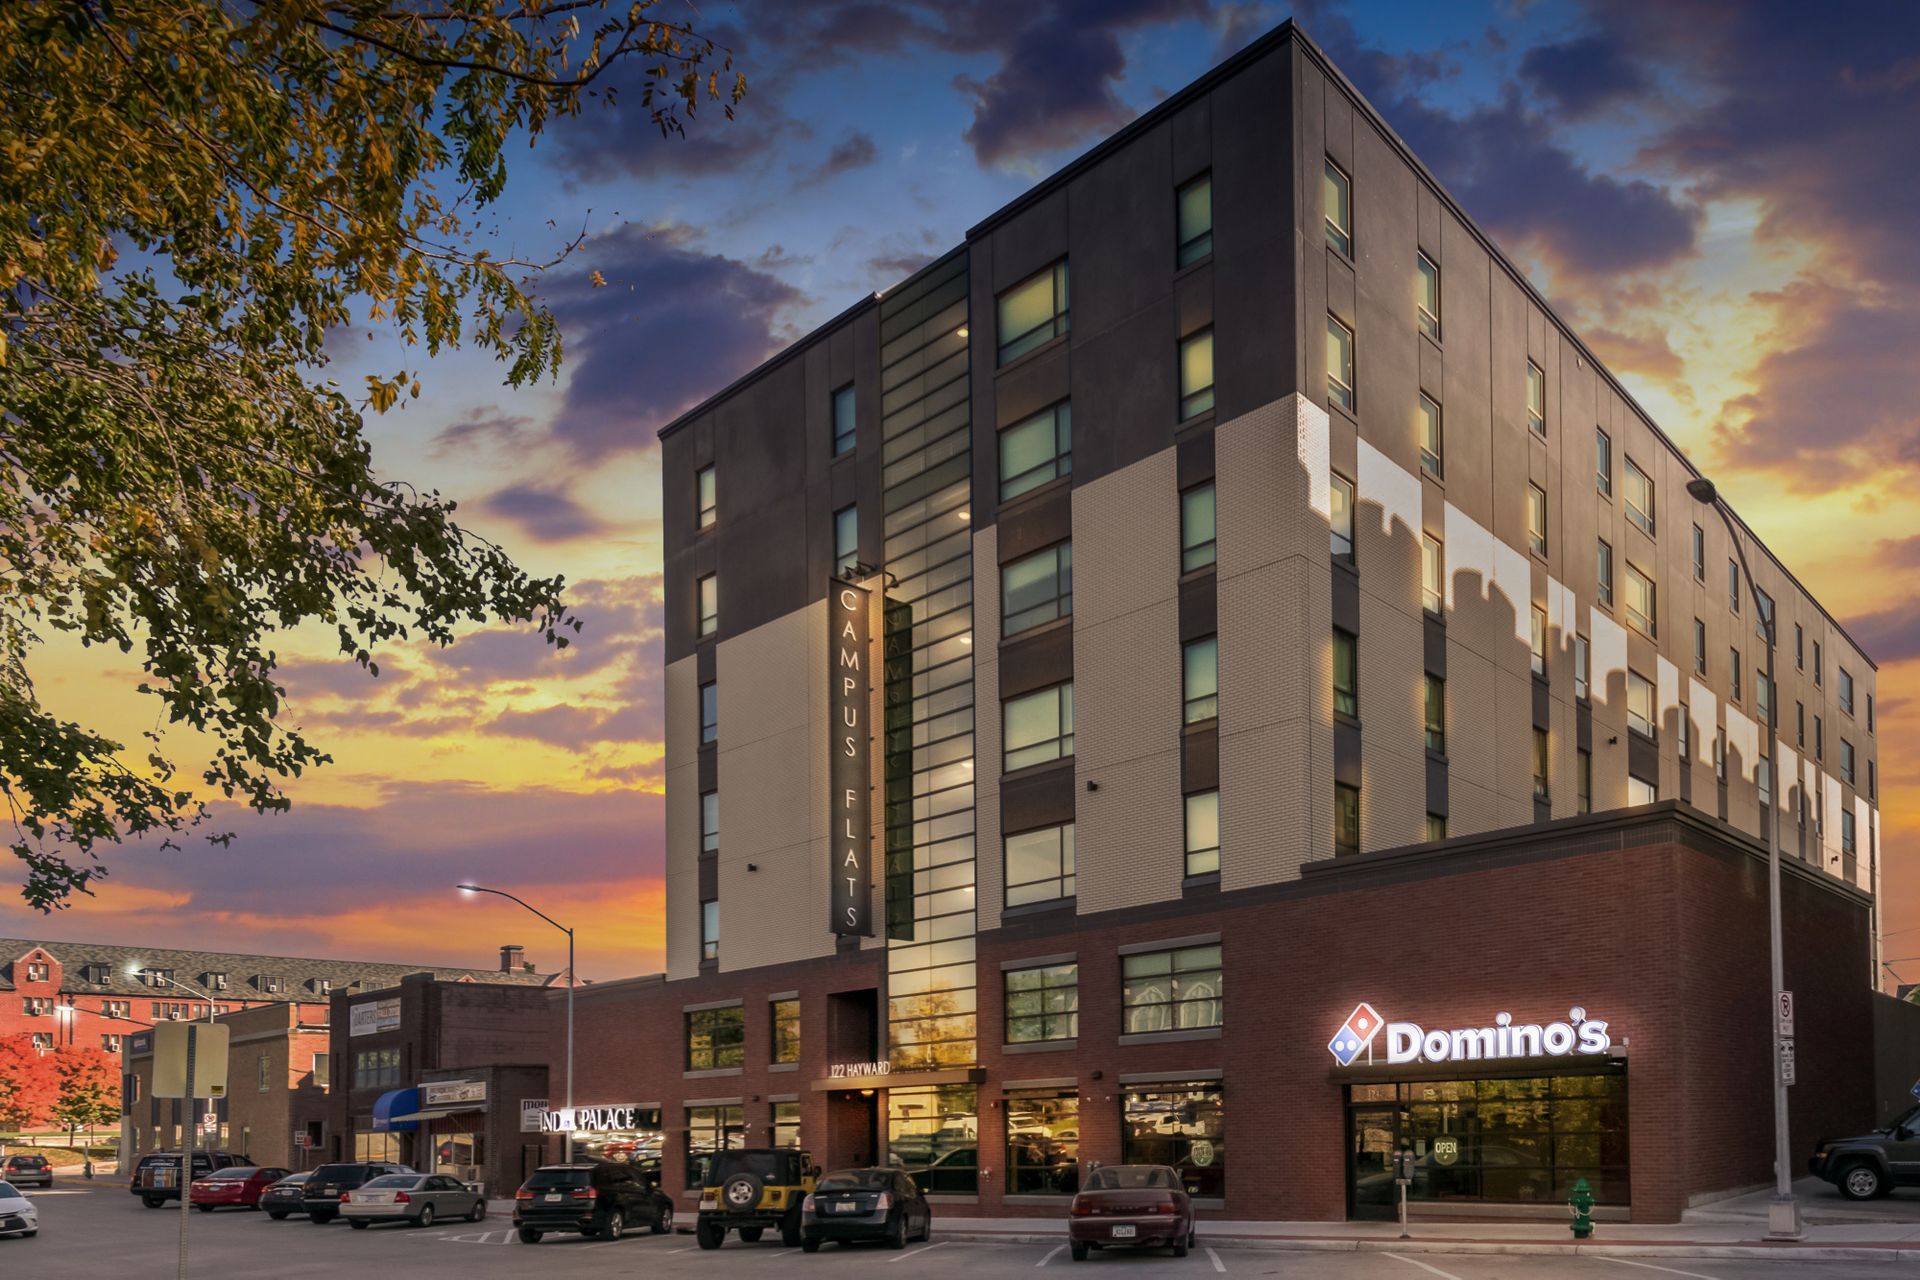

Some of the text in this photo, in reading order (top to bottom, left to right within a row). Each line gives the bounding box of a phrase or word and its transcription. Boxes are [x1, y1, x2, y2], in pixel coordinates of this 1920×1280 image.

[840, 590, 859, 927] CAMPUS FLATS
[1386, 1006, 1611, 1064] Domino's
[831, 1061, 891, 1078] 122 HAYWARD
[540, 1111, 577, 1132] IND
[581, 1108, 635, 1131] PALACE
[1435, 1142, 1457, 1154] OPEN
